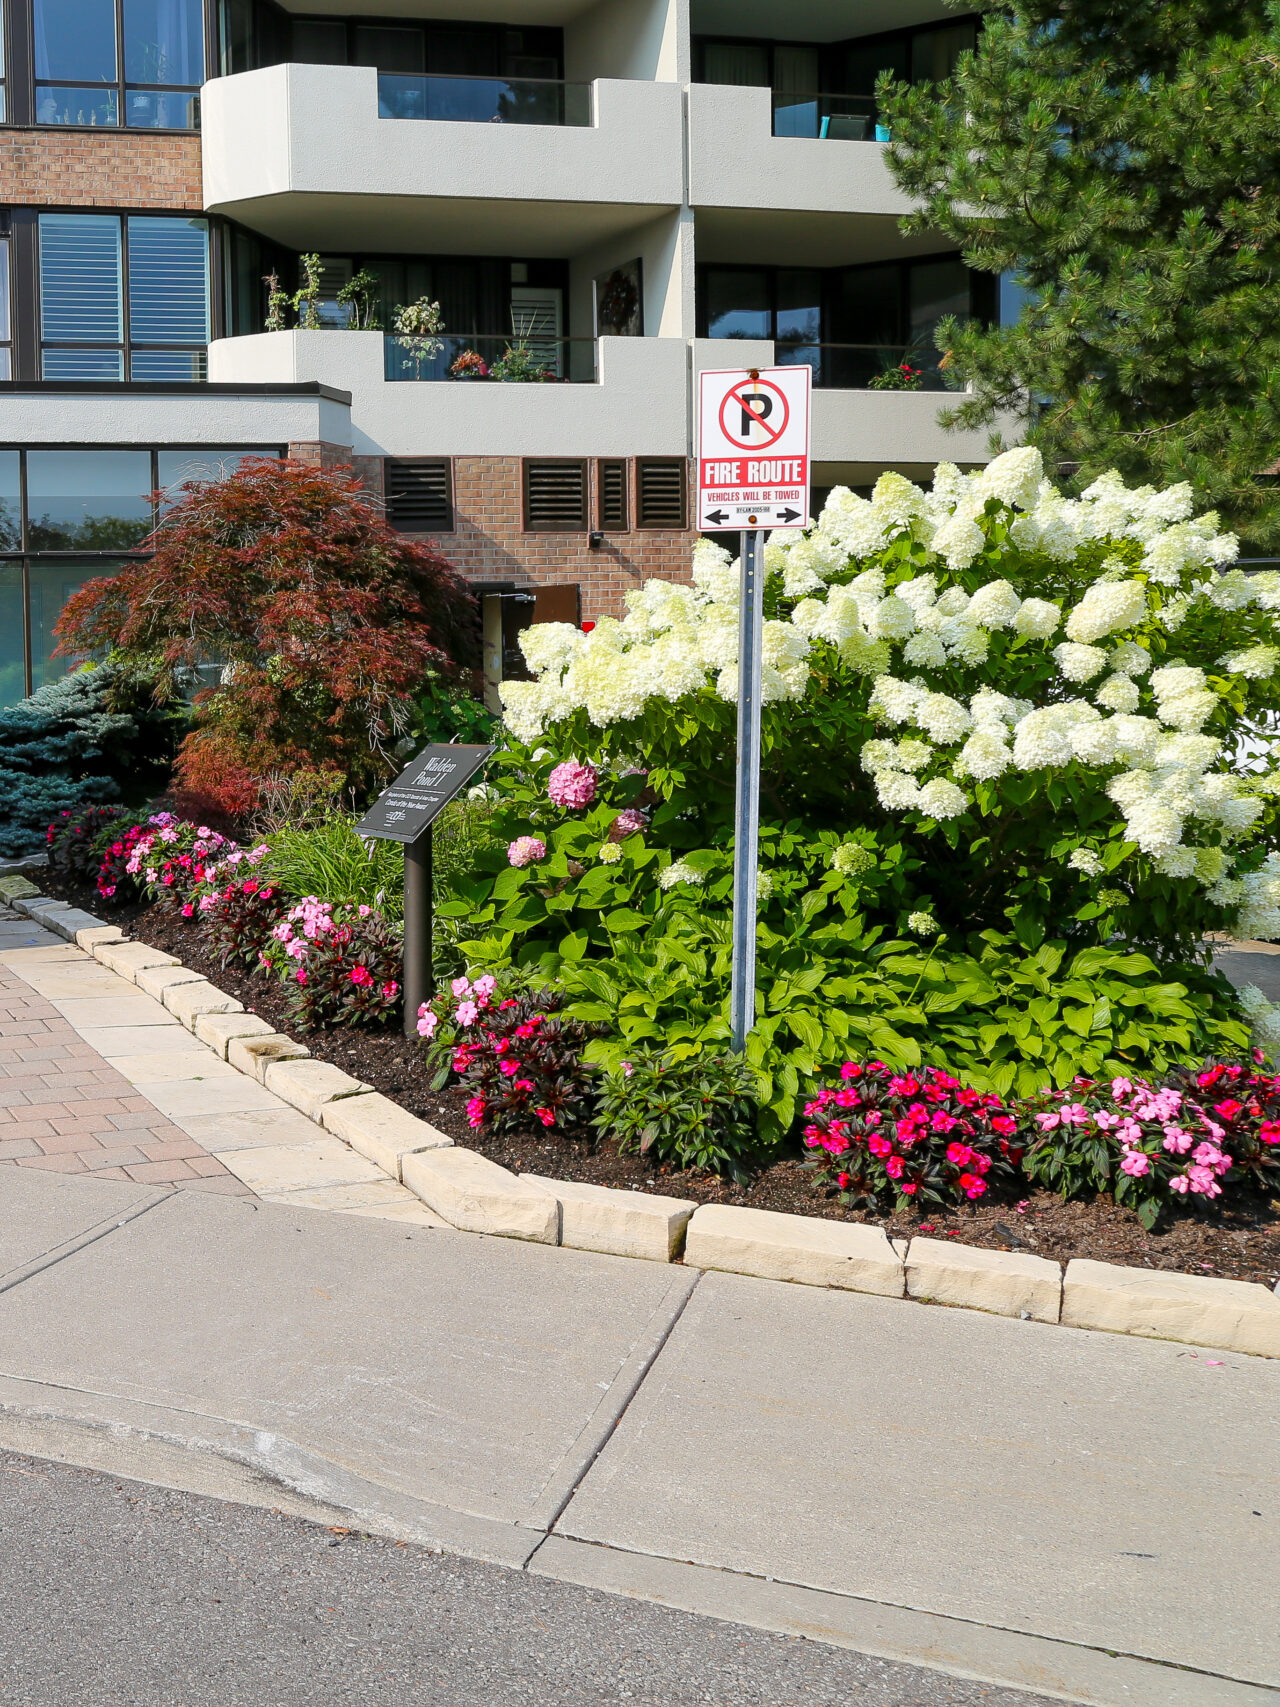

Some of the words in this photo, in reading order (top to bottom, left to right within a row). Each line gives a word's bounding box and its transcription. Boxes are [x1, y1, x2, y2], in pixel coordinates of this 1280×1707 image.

[741, 393, 773, 436] P
[705, 461, 741, 485] FIRE
[747, 459, 802, 483] ROUTE
[707, 491, 740, 502] VEHICLES
[742, 491, 760, 501] WILL
[762, 490, 772, 500] BE
[774, 490, 800, 500] TOWED
[423, 757, 457, 773] Walden
[410, 771, 441, 787] Pond
